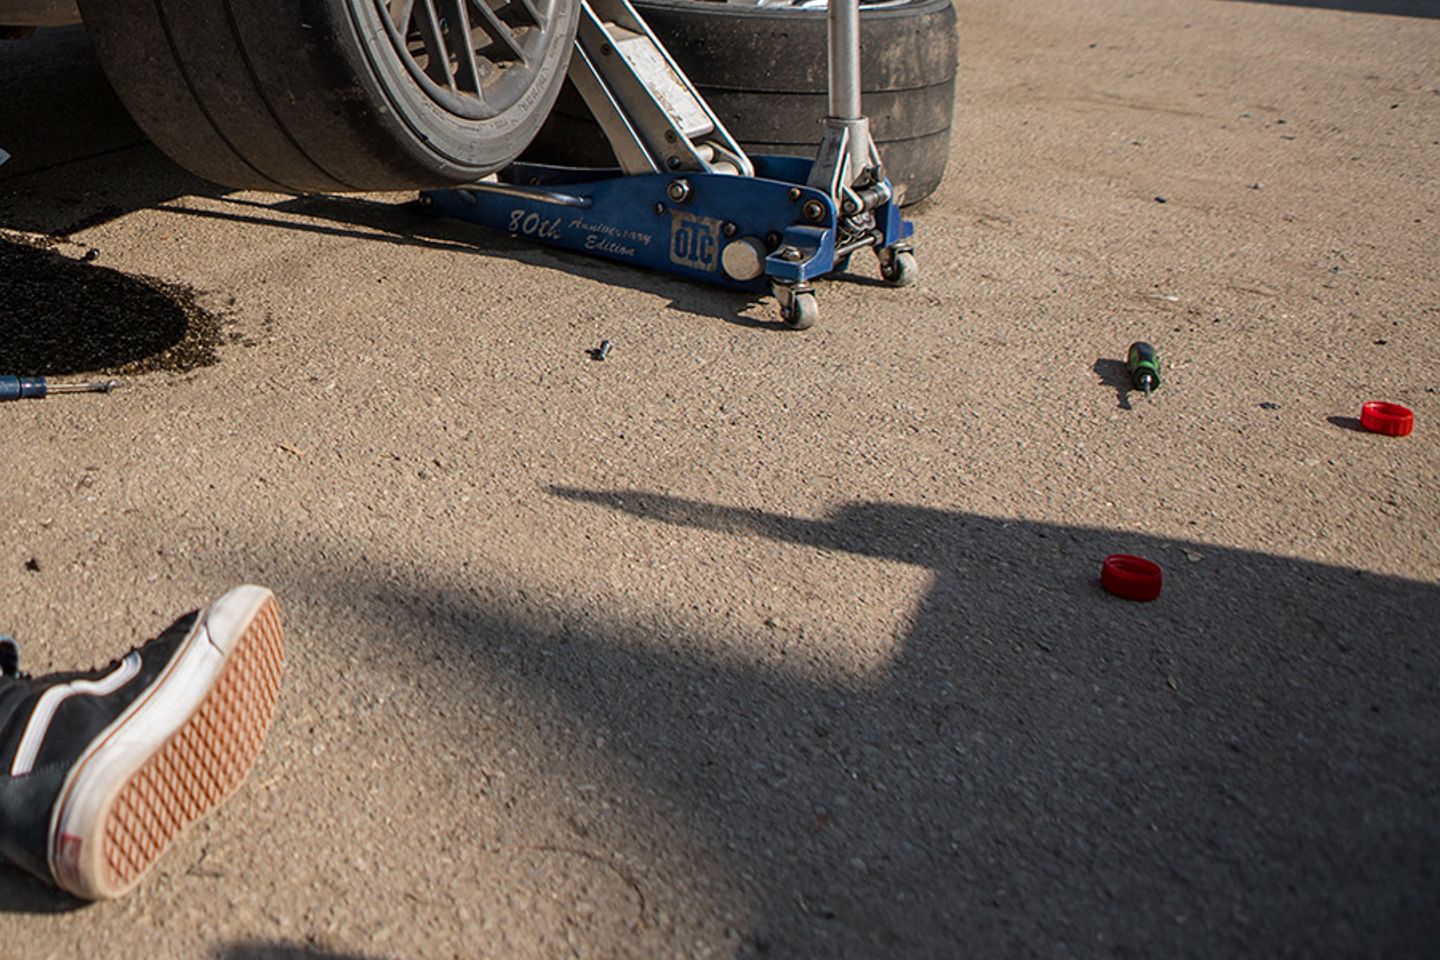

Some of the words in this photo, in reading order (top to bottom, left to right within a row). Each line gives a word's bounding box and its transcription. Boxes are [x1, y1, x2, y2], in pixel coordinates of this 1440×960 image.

[508, 209, 562, 240] 80th
[568, 217, 653, 246] Anniversary
[584, 234, 636, 257] Edition
[674, 220, 715, 264] OTC
